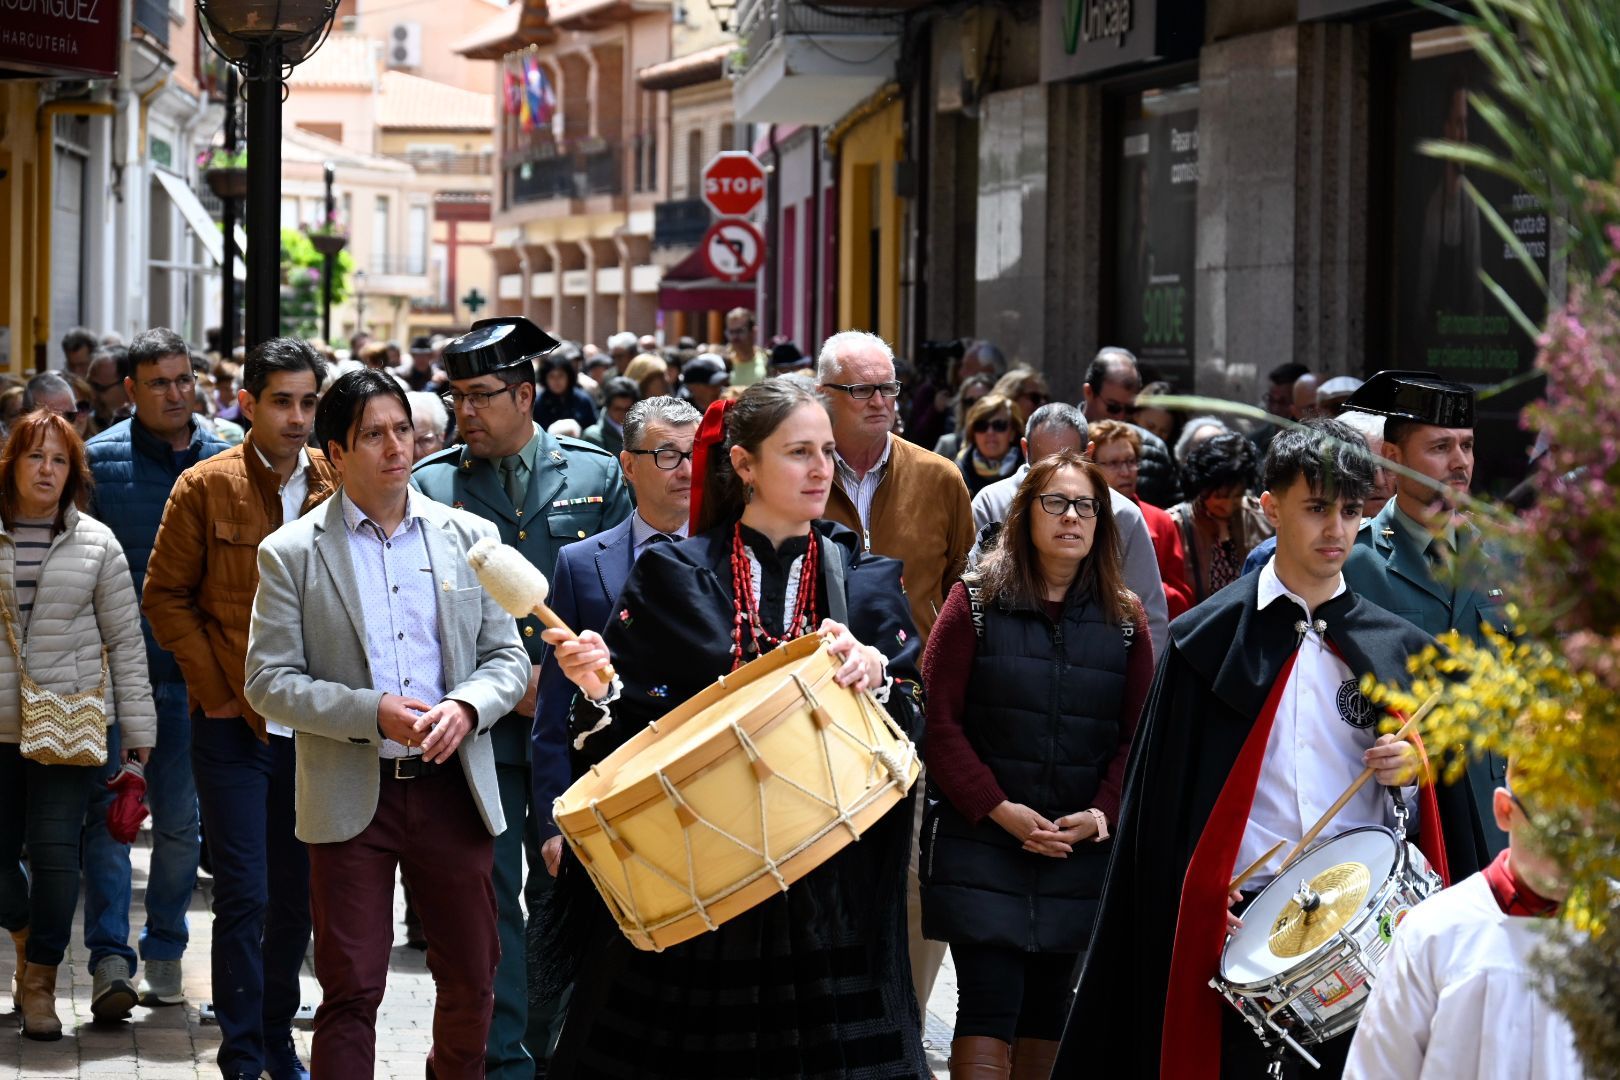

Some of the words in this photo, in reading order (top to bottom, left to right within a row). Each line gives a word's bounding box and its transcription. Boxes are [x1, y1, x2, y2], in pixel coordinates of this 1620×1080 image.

[0, 0, 99, 23] IGUEZ
[0, 29, 78, 55] HARCUTERÍA
[706, 177, 764, 193] STOP
